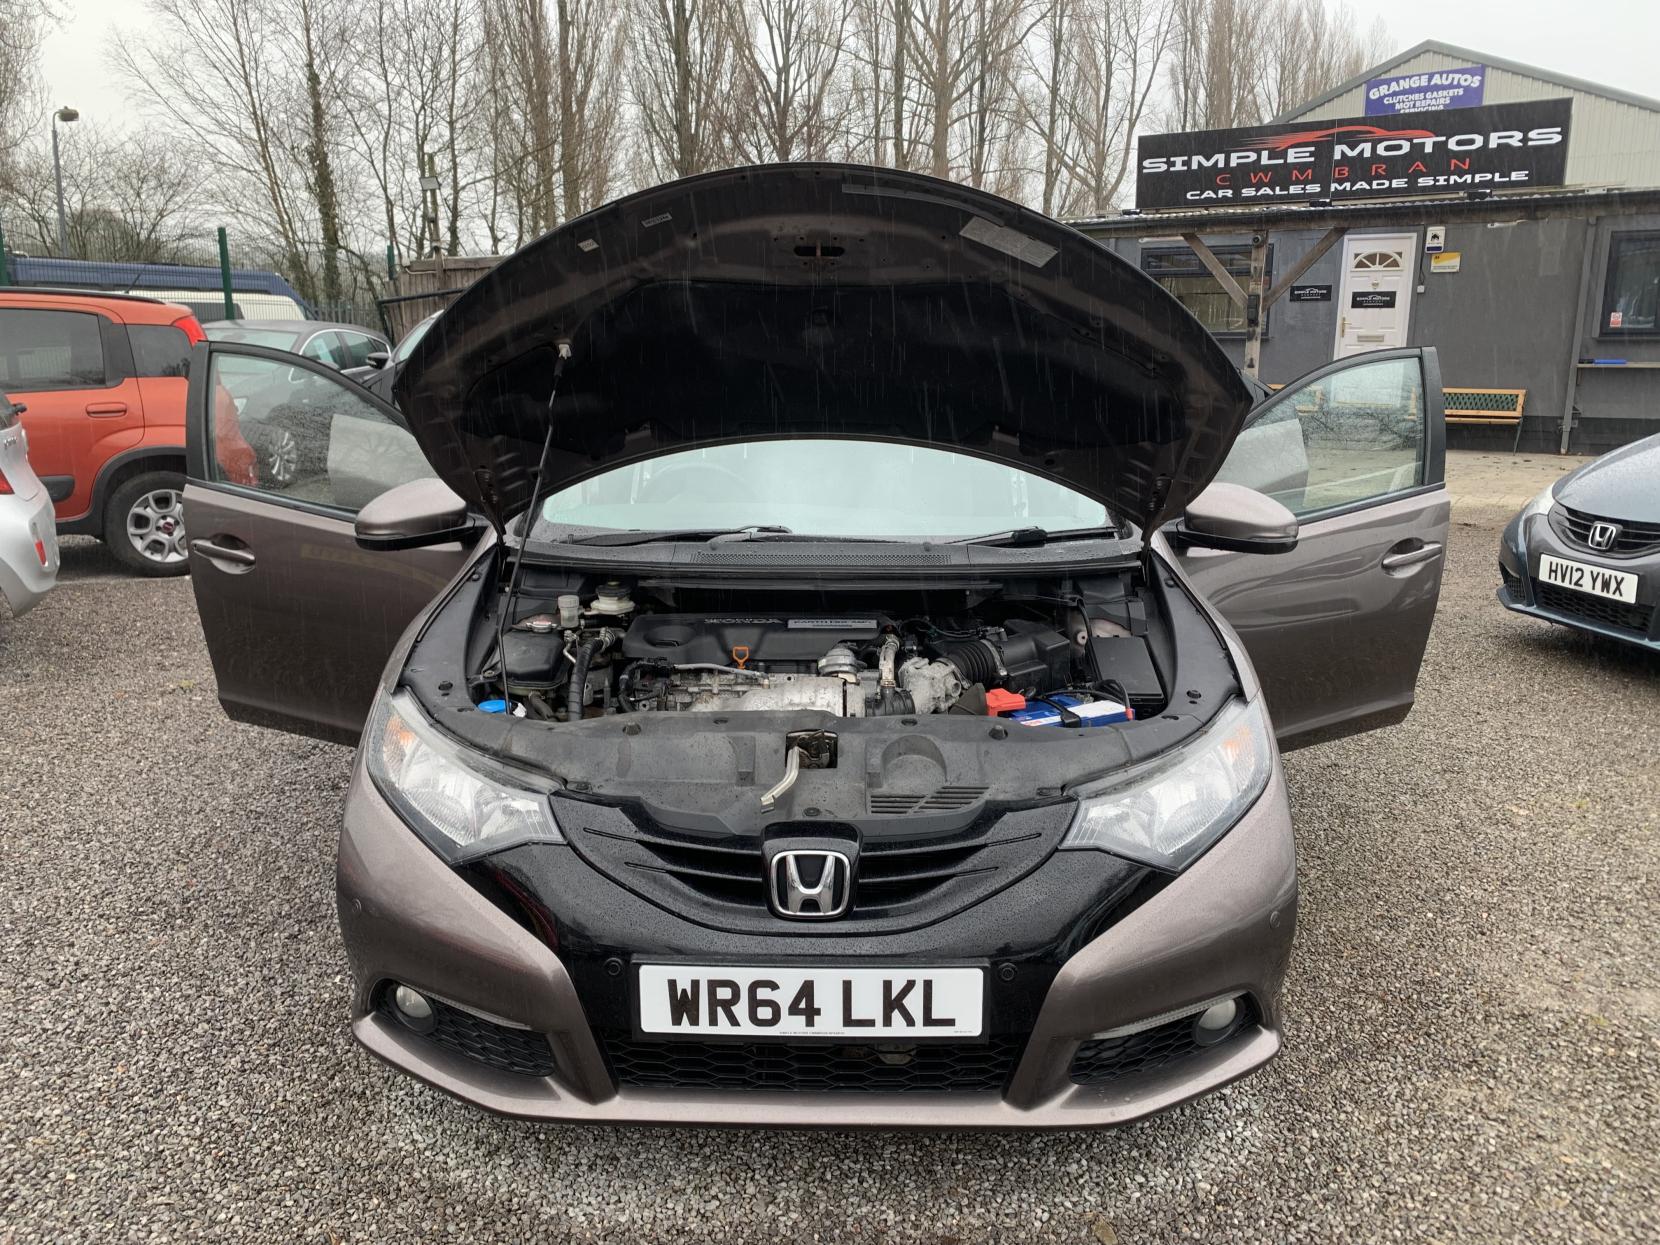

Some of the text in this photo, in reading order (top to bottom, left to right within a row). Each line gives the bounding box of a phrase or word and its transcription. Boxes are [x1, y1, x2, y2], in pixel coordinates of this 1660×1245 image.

[1369, 73, 1482, 100] GRANGE AUTOS
[1383, 88, 1464, 104] CLUTCHES GASKETS
[1395, 97, 1450, 110] MOT REPAIRS
[1142, 127, 1562, 173] SIMPLE MOTORS
[1186, 170, 1529, 200] CAR SALES MADE SIMPLE
[1548, 561, 1625, 597] HV12 YWX
[667, 978, 956, 1028] WR64 LKL
